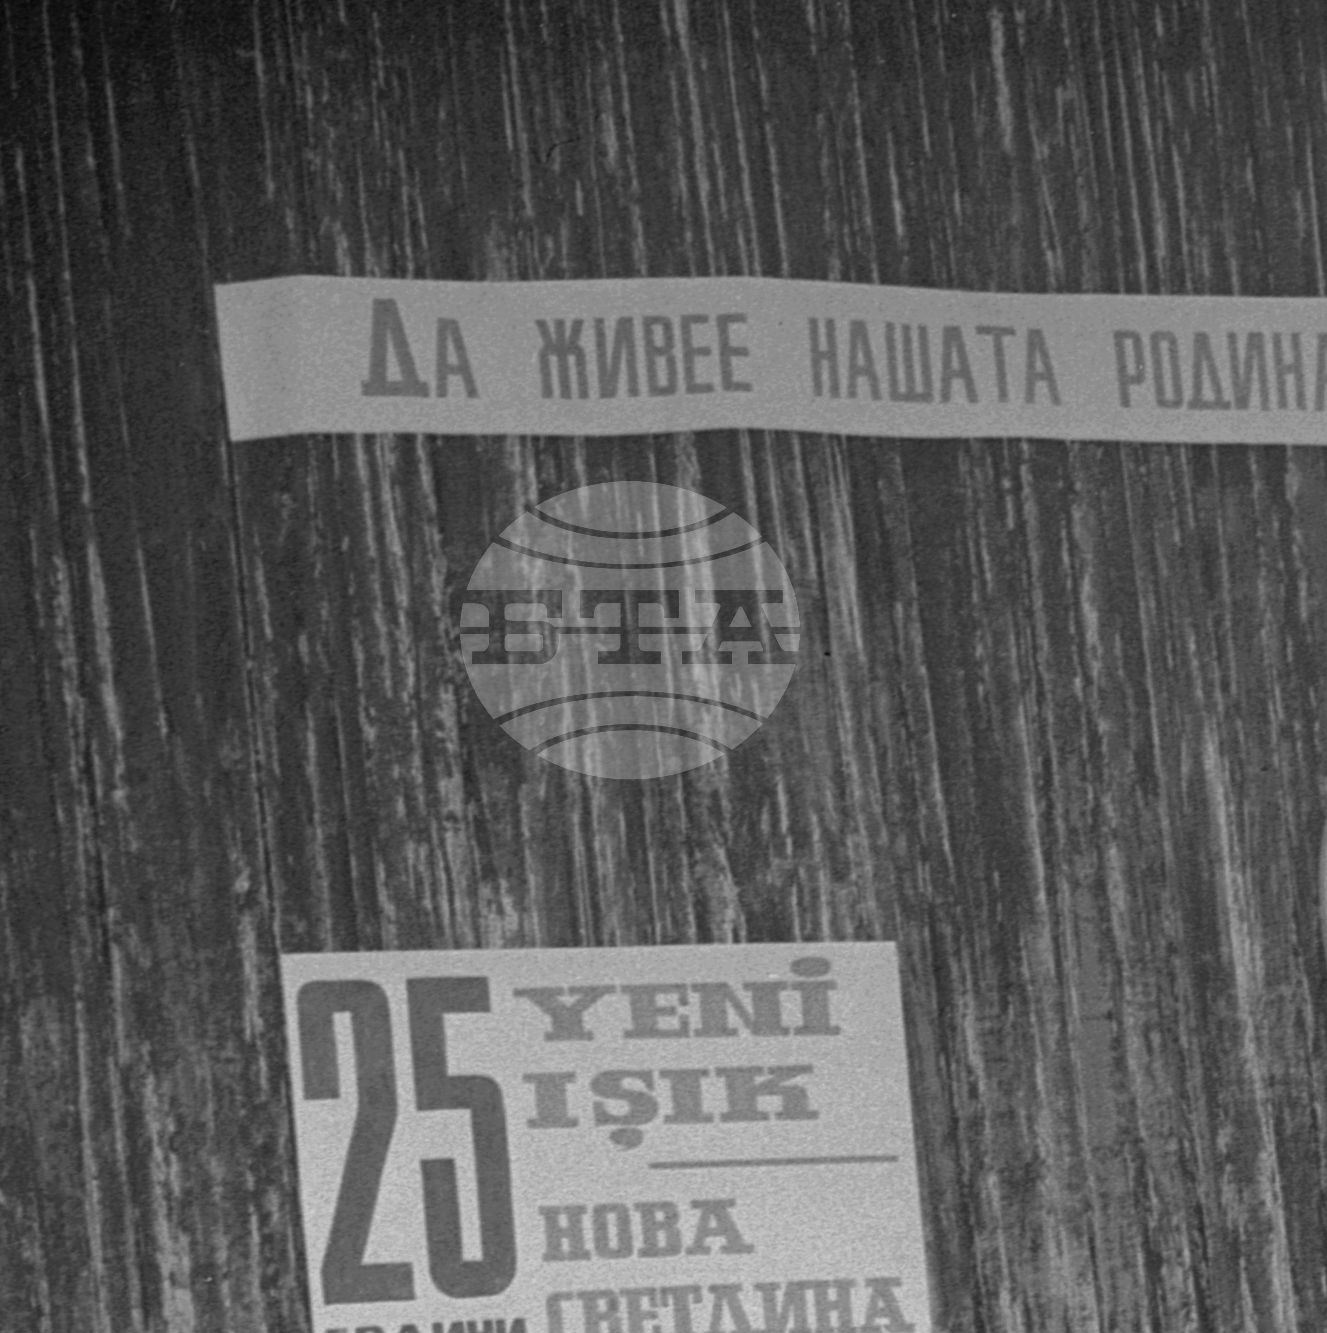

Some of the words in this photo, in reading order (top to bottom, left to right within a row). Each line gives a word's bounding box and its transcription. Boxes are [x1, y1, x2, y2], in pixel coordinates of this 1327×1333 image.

[361, 298, 478, 397] ДА
[534, 313, 753, 400] ЖИВЕЕ
[808, 316, 1061, 405] НАШАТА
[298, 975, 517, 1305] 25
[522, 1063, 820, 1150] IŞIK
[538, 1198, 755, 1262] НОВА
